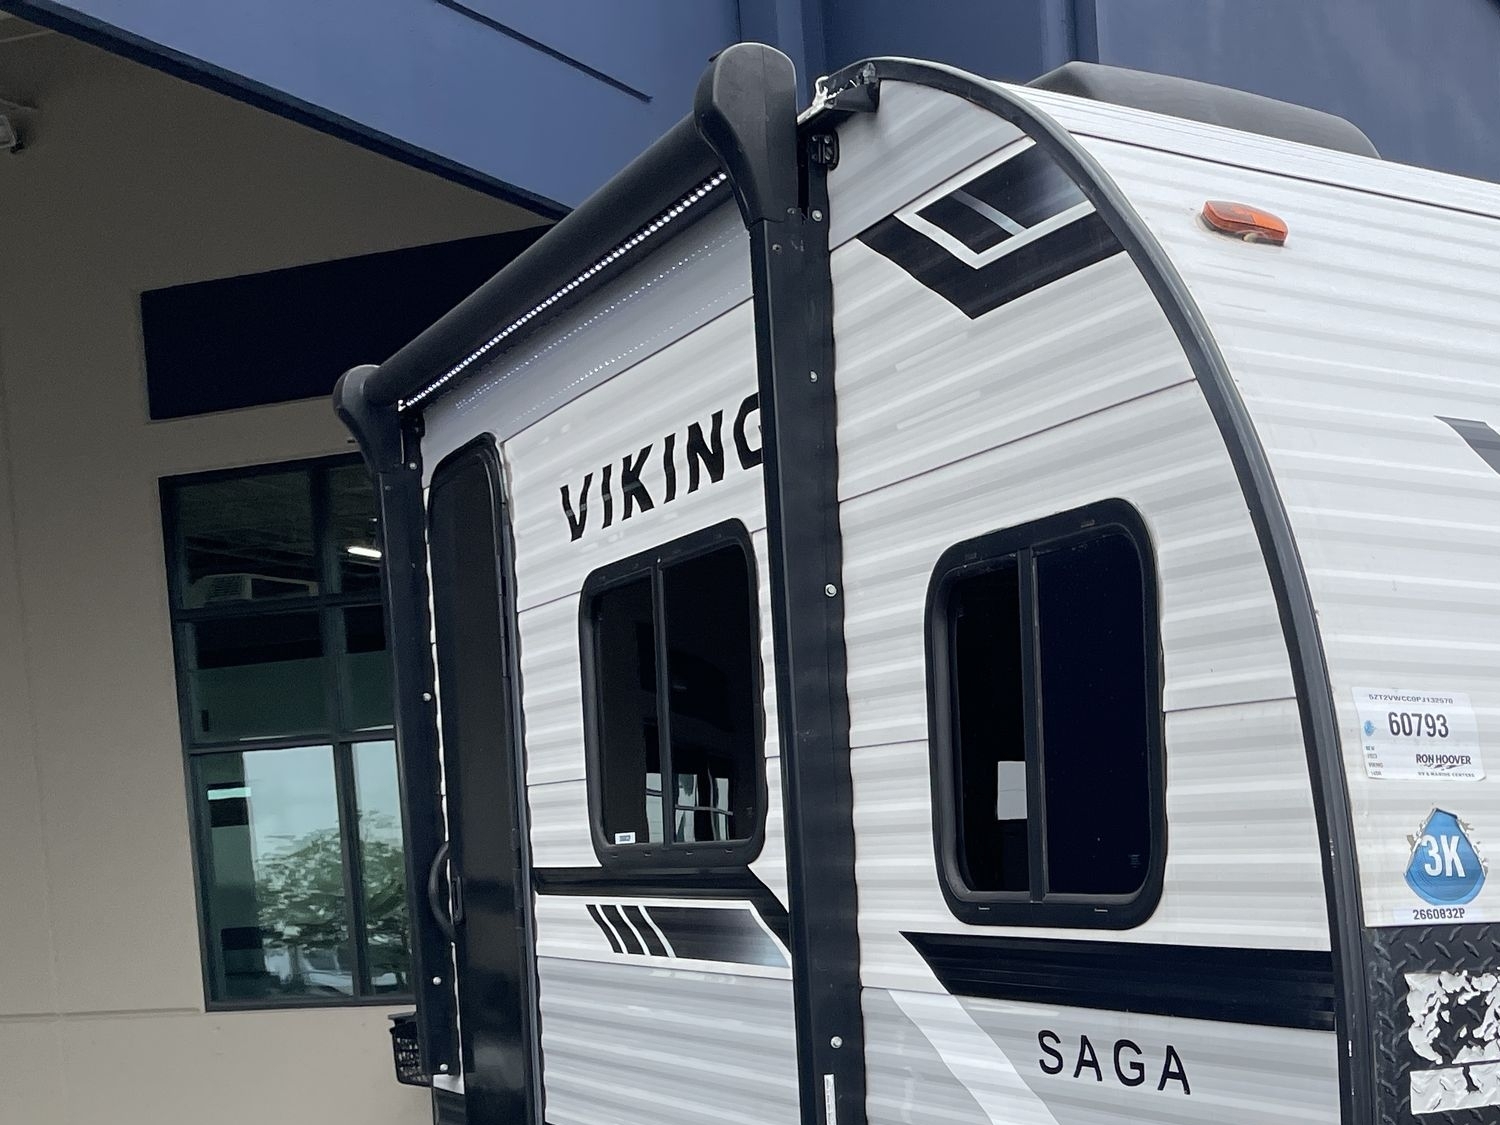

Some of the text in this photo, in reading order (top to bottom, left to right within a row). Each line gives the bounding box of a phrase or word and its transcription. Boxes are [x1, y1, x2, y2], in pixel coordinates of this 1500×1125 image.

[1388, 711, 1449, 738] 60793
[1416, 754, 1472, 765] RON HOOVER
[1422, 834, 1466, 878] 3K
[1412, 908, 1466, 920] 2660832P
[1038, 1030, 1192, 1095] SAGA
